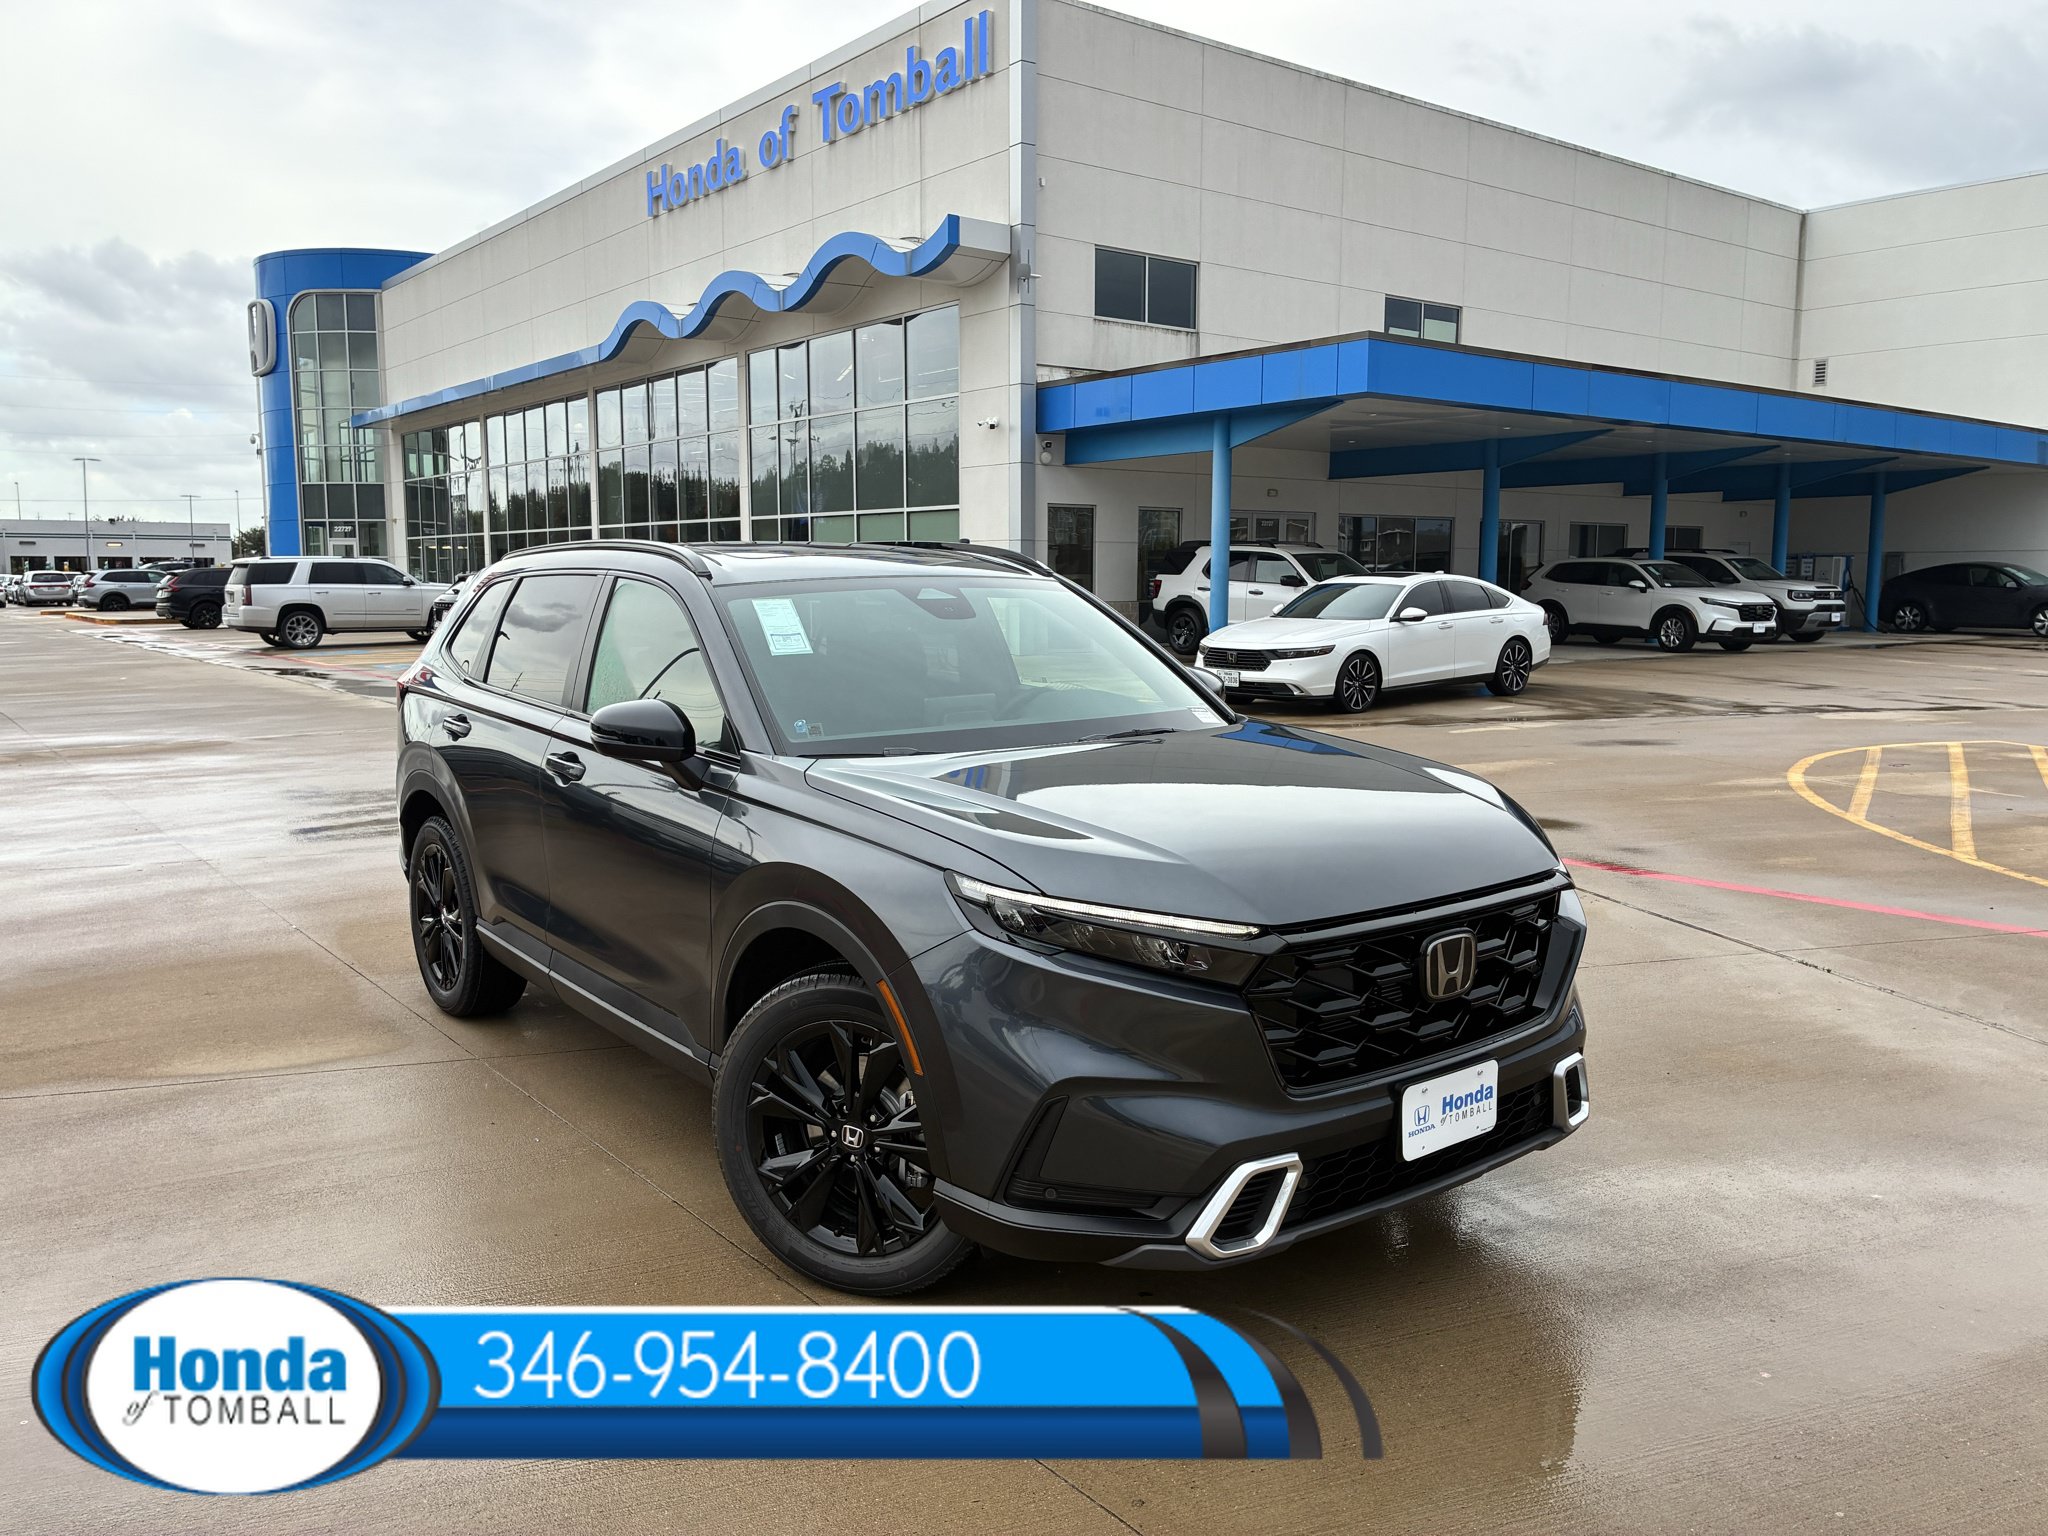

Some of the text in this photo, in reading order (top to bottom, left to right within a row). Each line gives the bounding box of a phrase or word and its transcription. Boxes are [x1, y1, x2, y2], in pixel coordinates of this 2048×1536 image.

[647, 10, 993, 217] Honda of Tomball
[1441, 1084, 1494, 1115] Honda
[1440, 1101, 1493, 1127] of TOMBALL
[1408, 1123, 1436, 1138] HONDA
